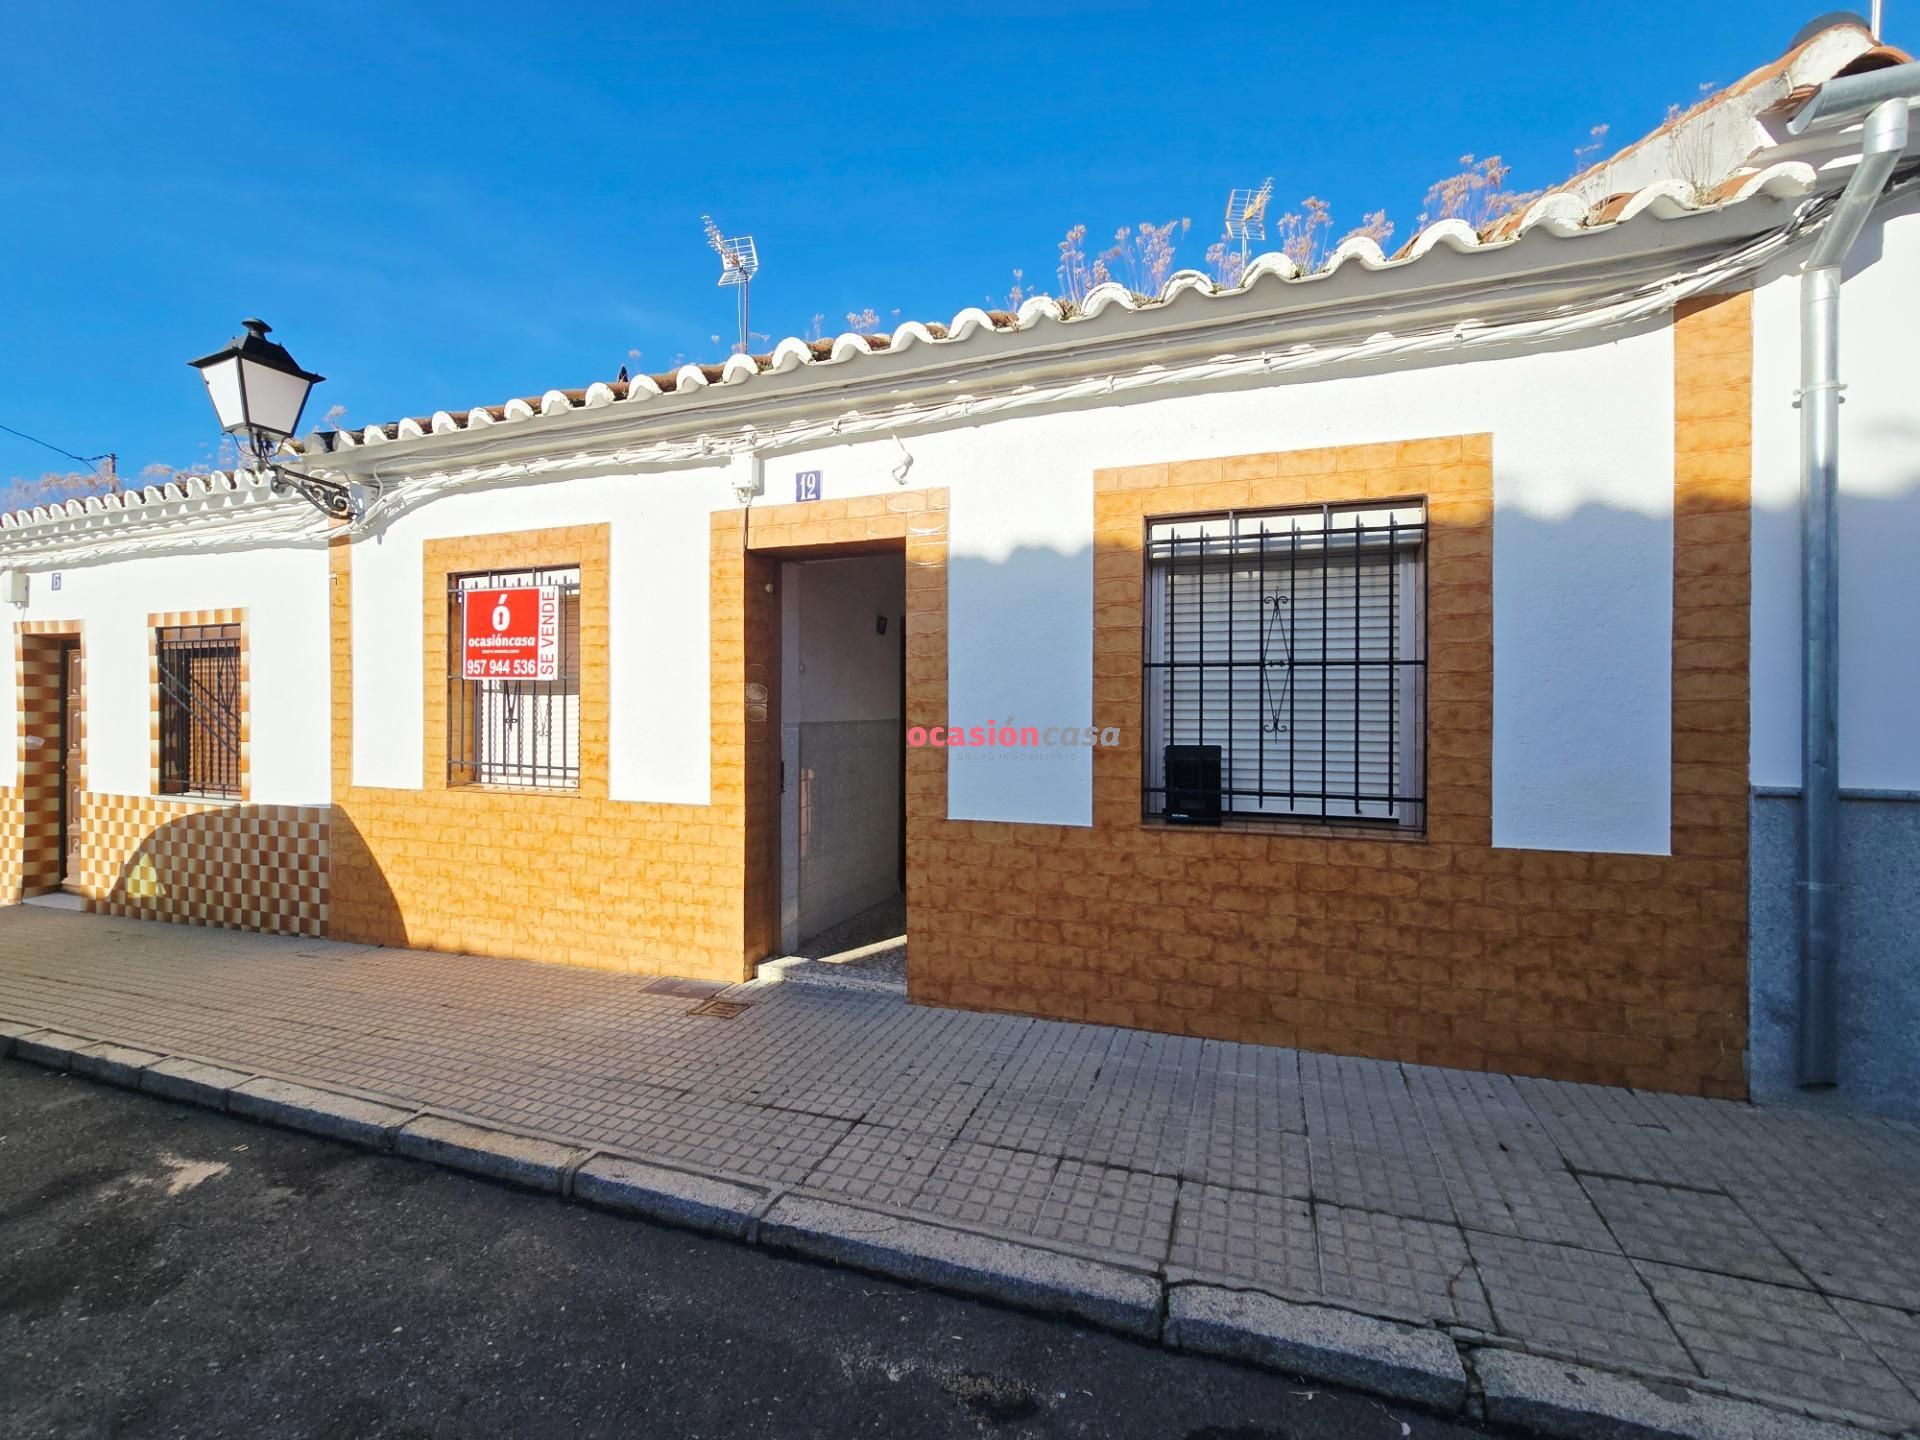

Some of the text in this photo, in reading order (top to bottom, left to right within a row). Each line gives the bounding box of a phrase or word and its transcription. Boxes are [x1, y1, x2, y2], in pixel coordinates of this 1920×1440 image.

[800, 473, 816, 500] 12
[468, 633, 536, 647] ocasióncasa
[540, 590, 555, 675] SE VENDE
[467, 659, 536, 675] 957 944 536
